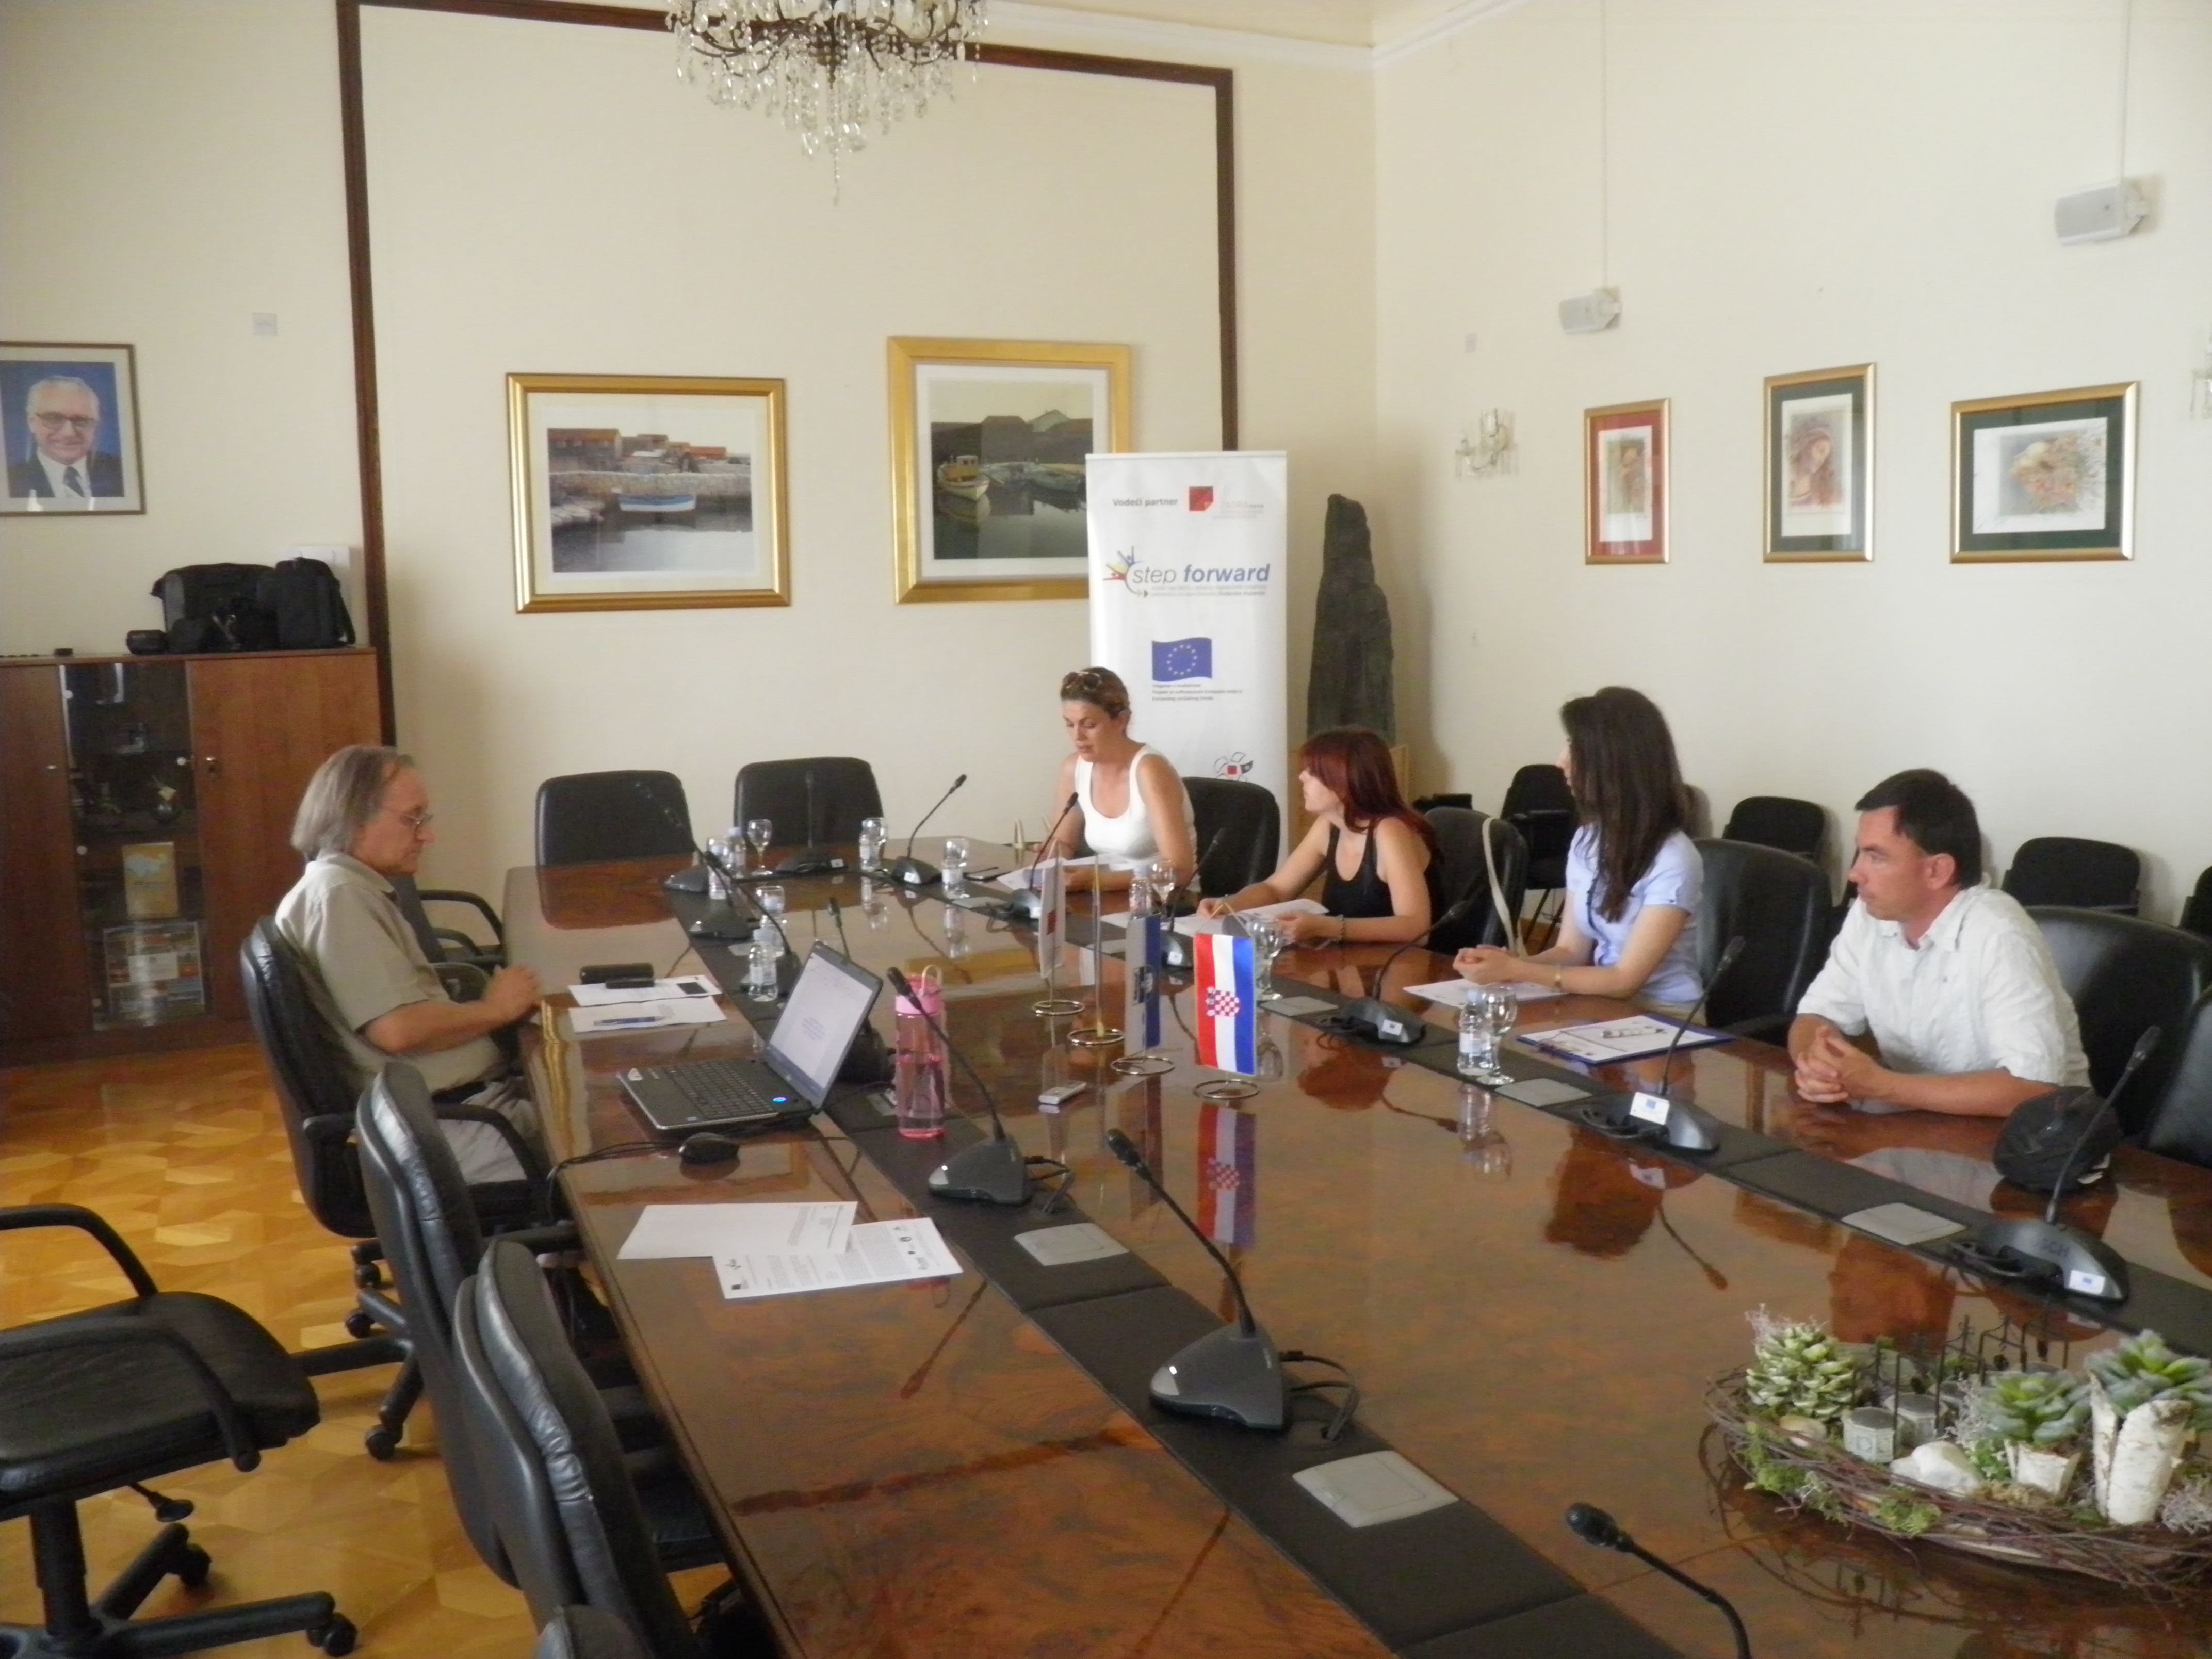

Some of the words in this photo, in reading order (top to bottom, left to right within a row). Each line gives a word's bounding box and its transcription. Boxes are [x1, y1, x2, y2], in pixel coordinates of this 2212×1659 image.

[1112, 497, 1142, 506] Vodeći
[1145, 498, 1178, 507] partner
[1132, 566, 1177, 585] step
[1183, 563, 1271, 583] forward
